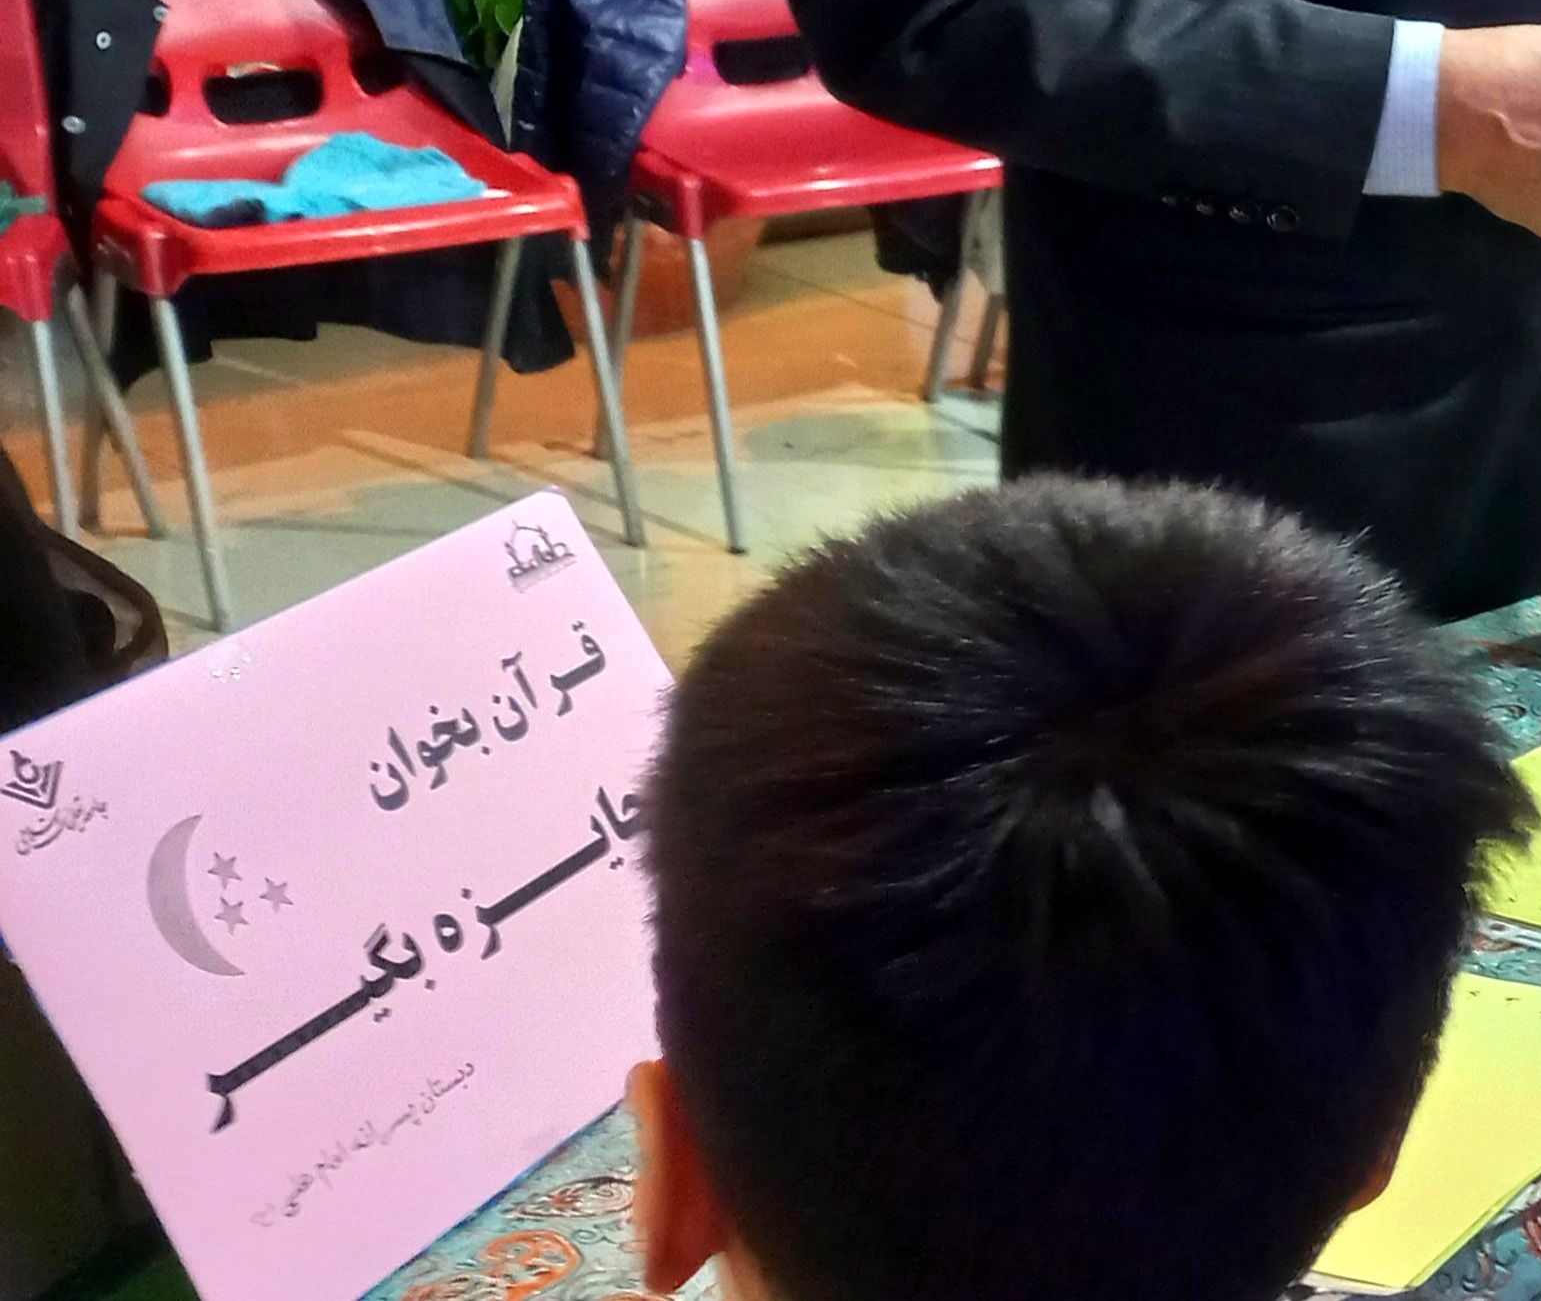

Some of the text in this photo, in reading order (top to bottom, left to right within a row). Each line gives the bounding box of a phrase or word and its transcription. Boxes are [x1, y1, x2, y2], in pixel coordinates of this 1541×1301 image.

[369, 621, 605, 812] قرآن بخوان
[207, 922, 436, 1134] بگیر
